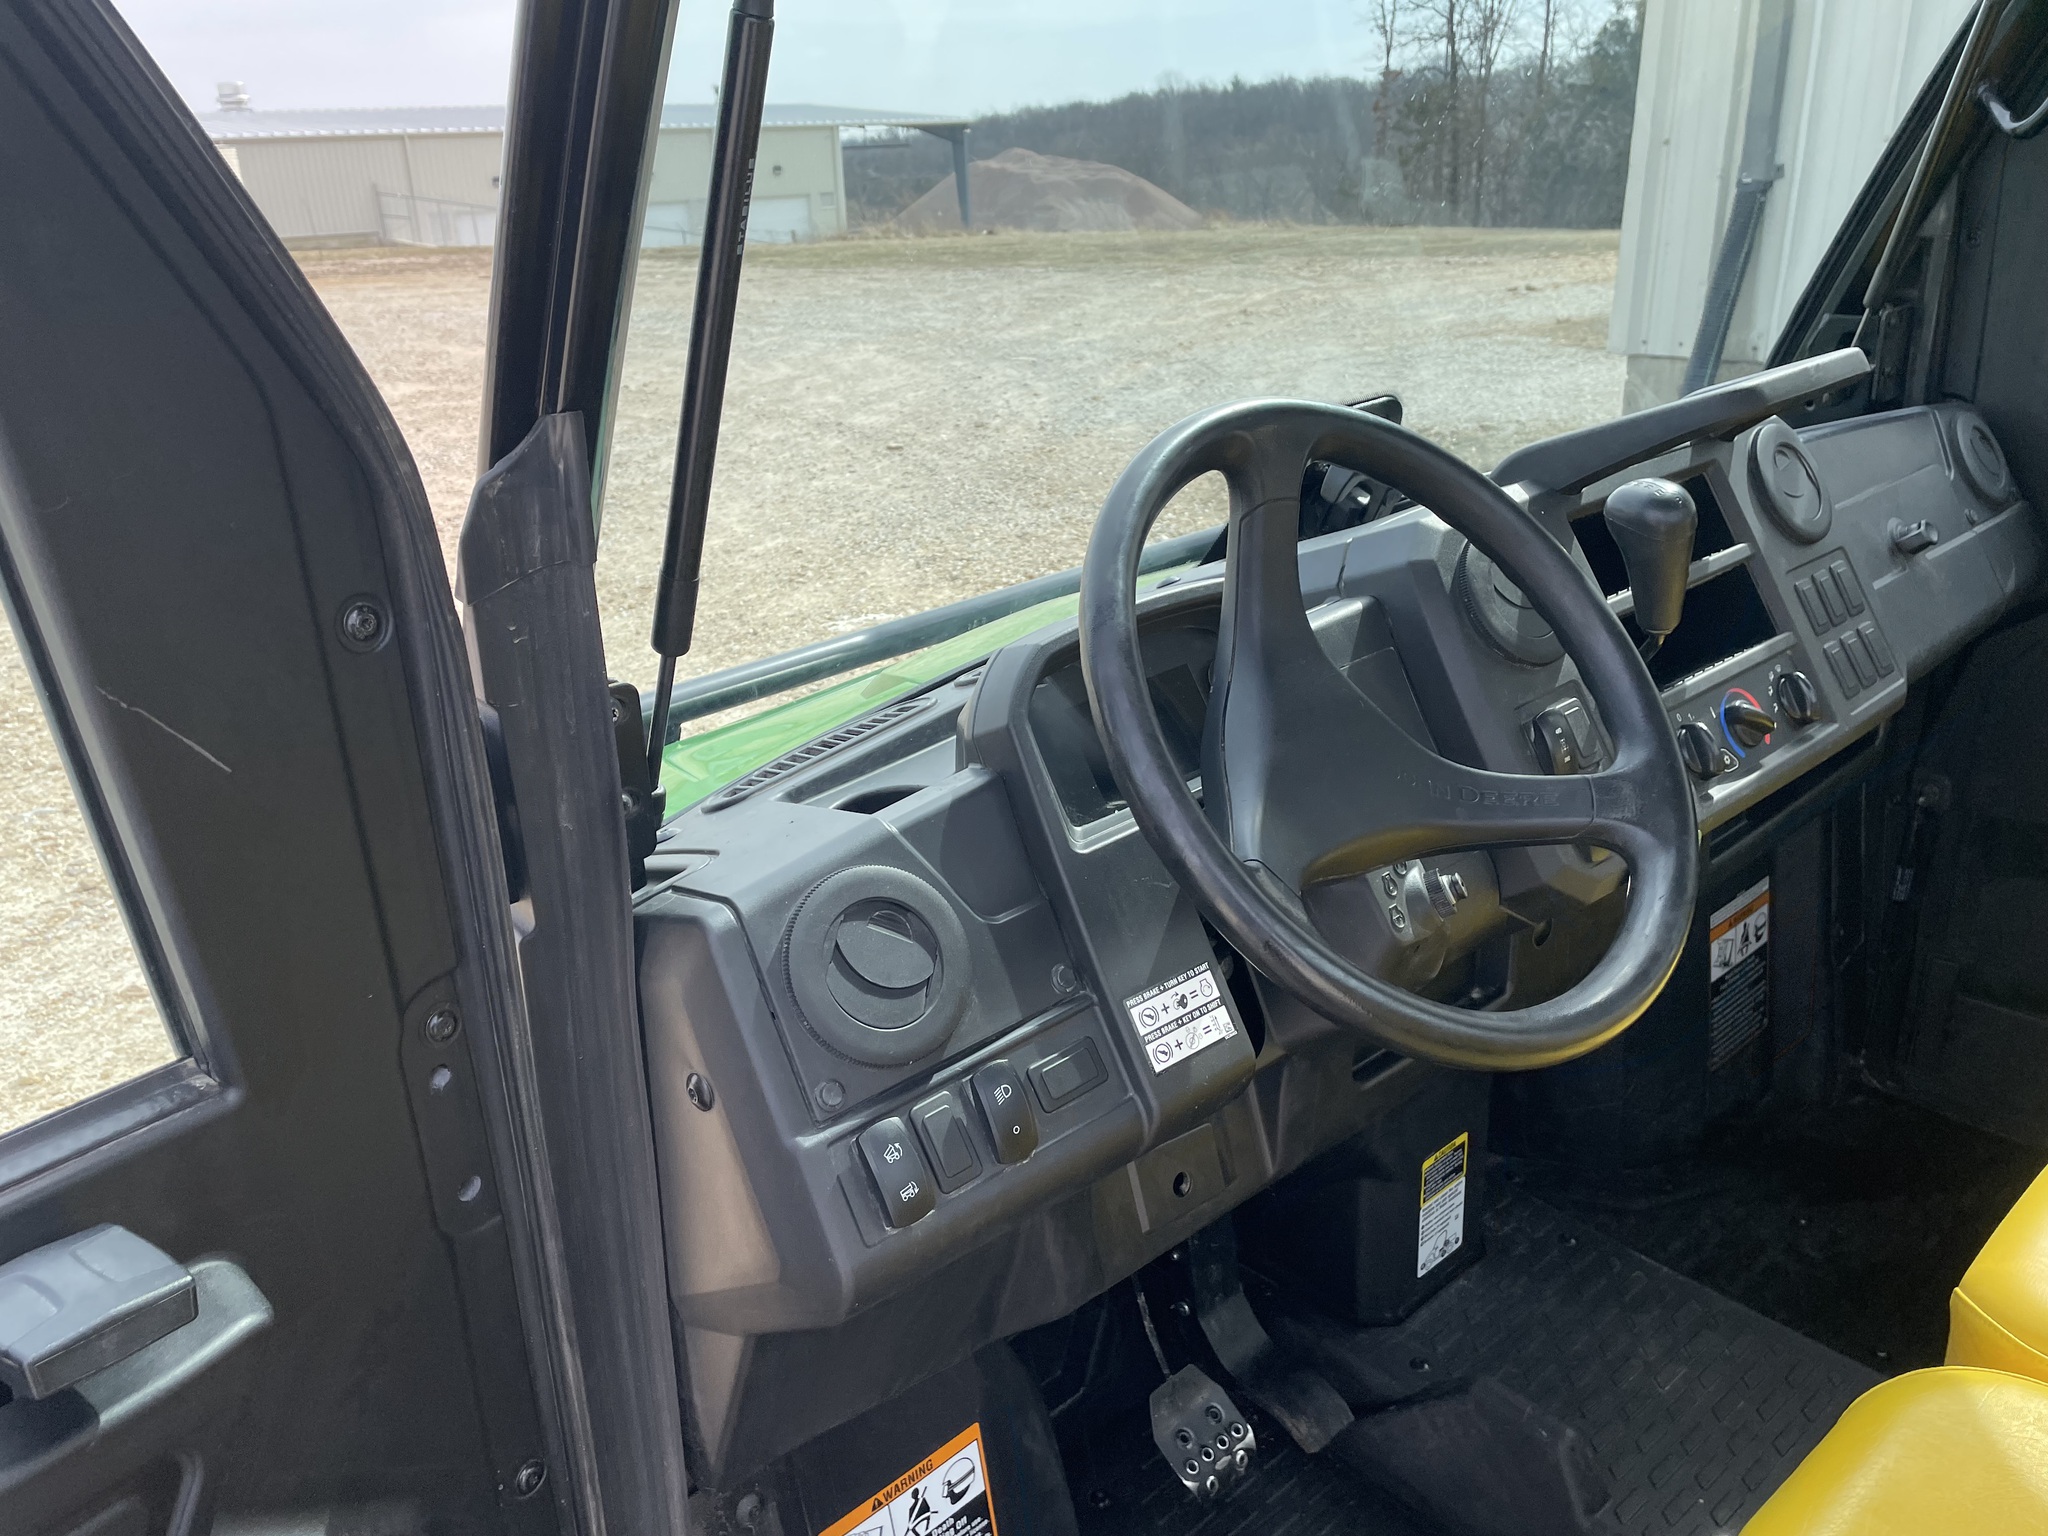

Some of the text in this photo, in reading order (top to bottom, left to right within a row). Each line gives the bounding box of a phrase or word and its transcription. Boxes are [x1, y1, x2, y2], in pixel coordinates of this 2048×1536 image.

[737, 158, 755, 256] STABILUS
[1459, 785, 1560, 807] DEERE
[1125, 995, 1143, 1008] PRESS
[1142, 987, 1160, 1000] BRAKE
[1163, 977, 1178, 989] TURN
[1177, 971, 1188, 983] KEY
[1186, 969, 1195, 978] TO
[1193, 961, 1210, 974] START
[1144, 1030, 1162, 1043] PRESS
[1161, 1021, 1179, 1034] BRAKE
[1182, 1014, 1193, 1023] KEY
[1191, 1009, 1201, 1018] ON
[1200, 1005, 1208, 1014] TO
[1206, 998, 1222, 1011] SHIFT
[882, 1458, 934, 1503] WARNING
